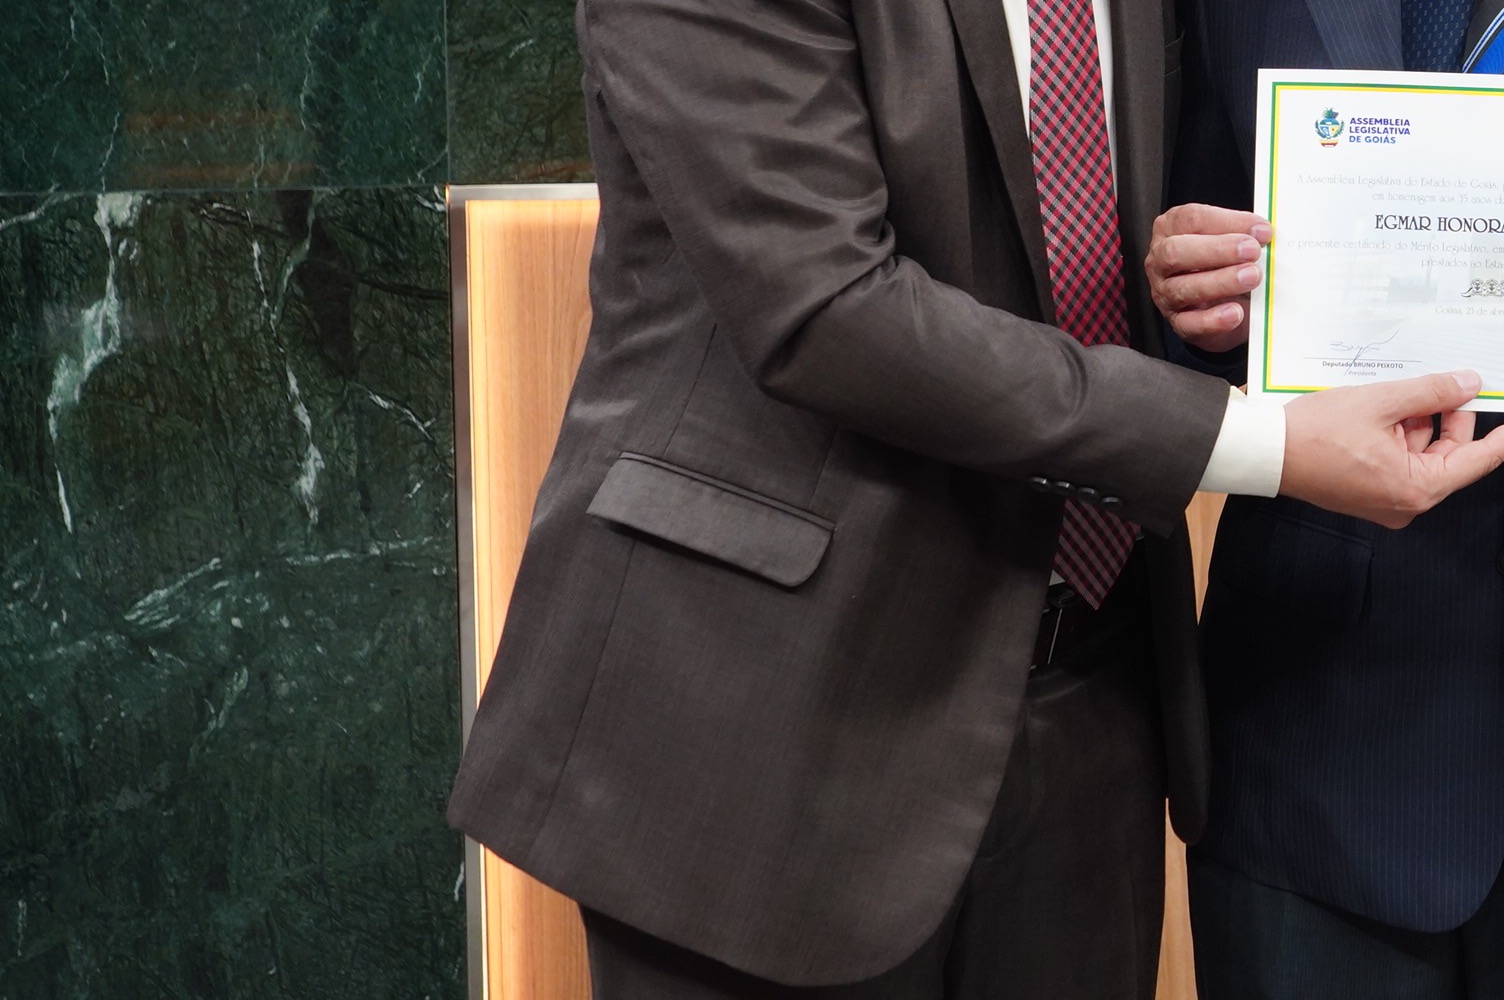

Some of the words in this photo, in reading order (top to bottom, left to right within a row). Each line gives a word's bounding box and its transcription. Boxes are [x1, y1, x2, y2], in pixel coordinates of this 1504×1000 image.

[1349, 117, 1411, 127] ASSEMBLEIA
[1349, 126, 1411, 135] LEGISLATIVA
[1349, 135, 1361, 143] DE
[1365, 135, 1396, 144] GOIÁS
[1306, 174, 1355, 185] Assembleia
[1358, 175, 1402, 188] Legislativa
[1404, 176, 1418, 186] do
[1420, 177, 1451, 188] Estado
[1454, 178, 1467, 188] de
[1371, 193, 1384, 201] em
[1387, 191, 1436, 205] homenagem
[1439, 194, 1455, 203] aos
[1458, 193, 1468, 203] 35
[1471, 195, 1491, 204] anos
[1375, 214, 1432, 231] EGMAR
[1297, 239, 1340, 250] presente
[1343, 239, 1391, 250] certificado
[1394, 240, 1408, 250] do
[1411, 240, 1439, 252] Mérito
[1492, 246, 1504, 254] em
[1421, 257, 1468, 269] prestados
[1470, 260, 1482, 268] ao
[1477, 306, 1488, 315] de
[1322, 361, 1352, 369] Deputado
